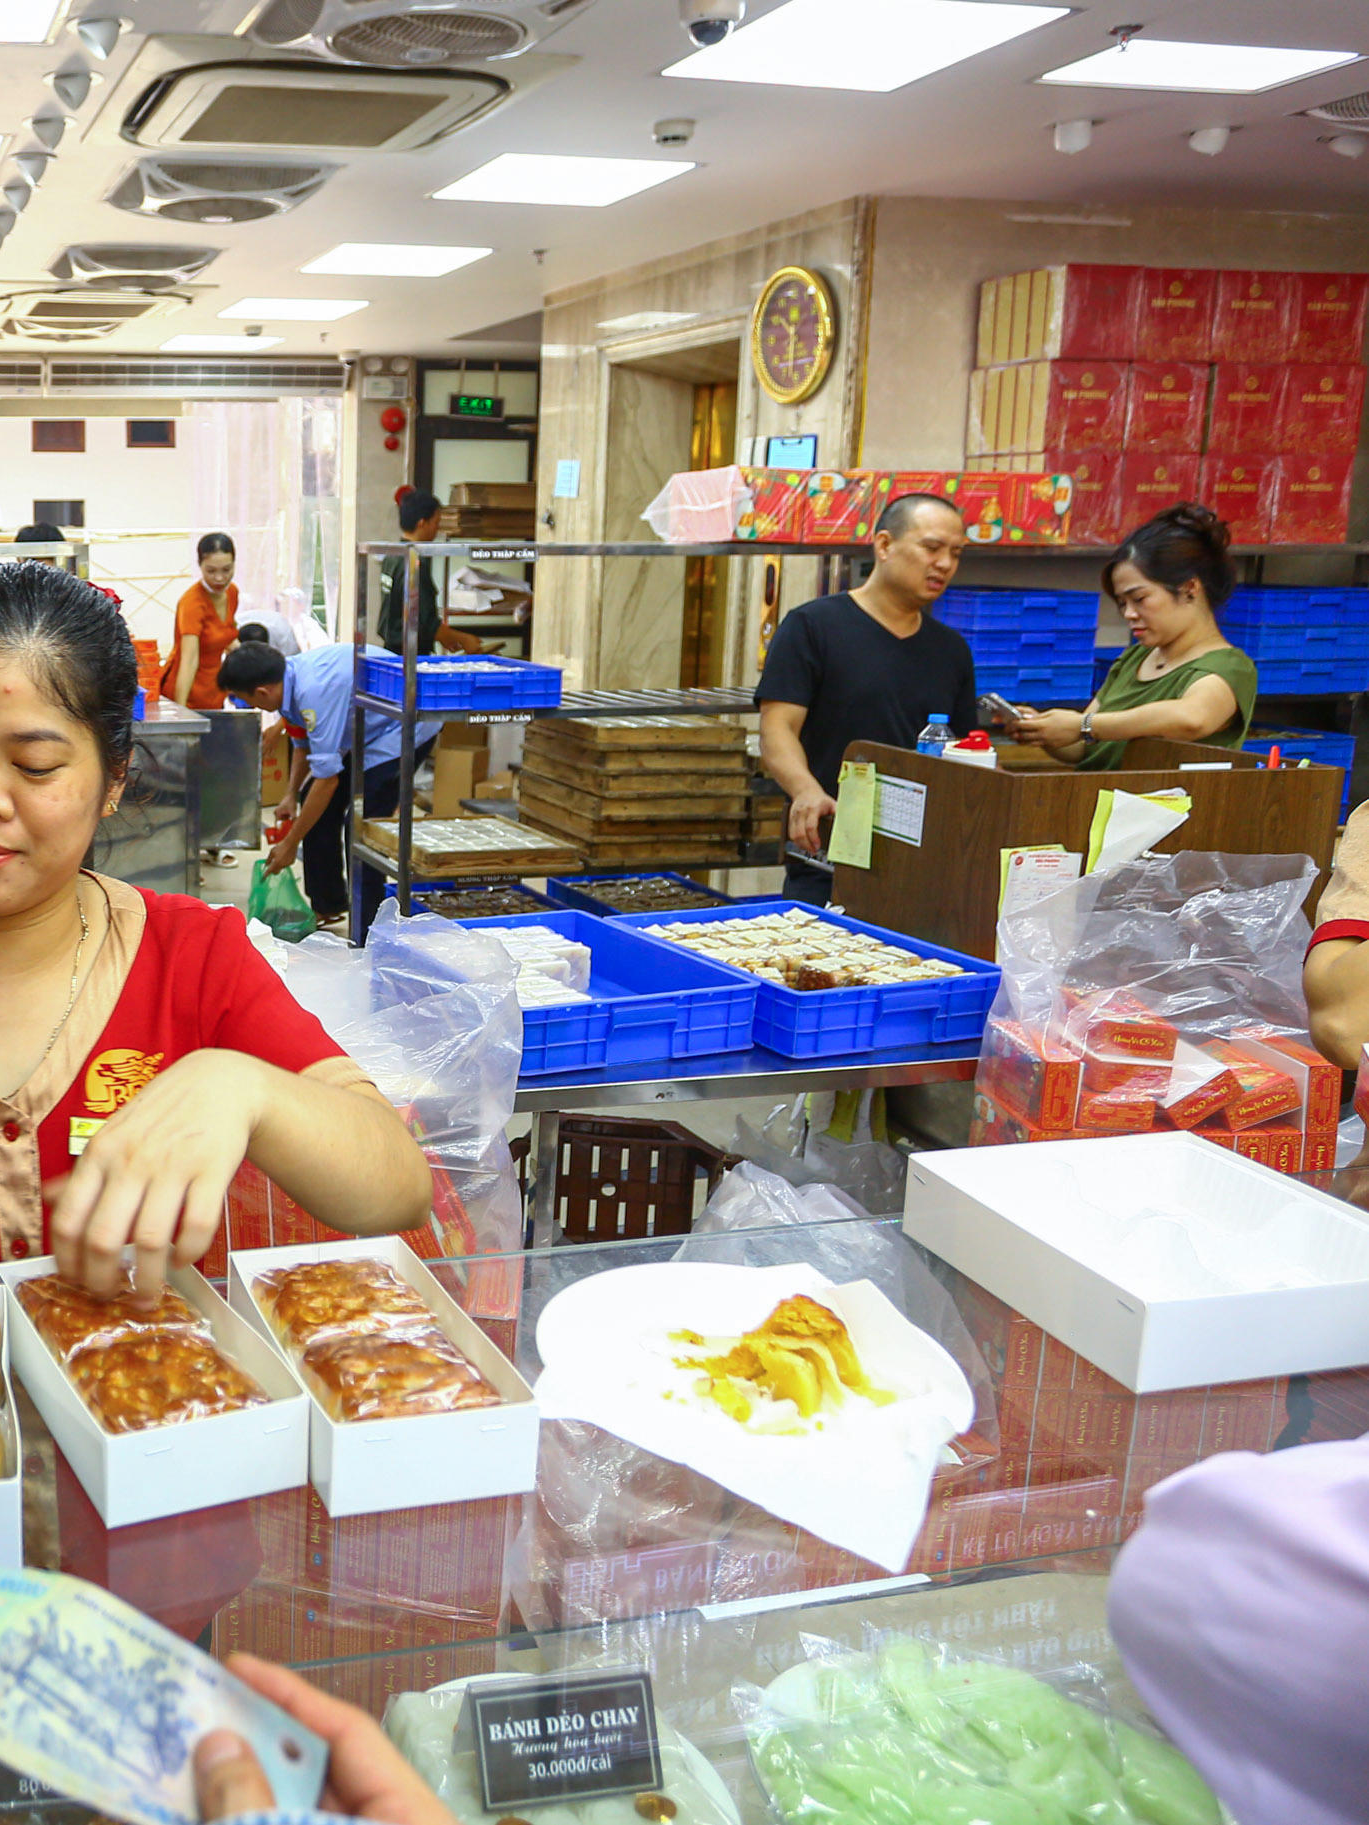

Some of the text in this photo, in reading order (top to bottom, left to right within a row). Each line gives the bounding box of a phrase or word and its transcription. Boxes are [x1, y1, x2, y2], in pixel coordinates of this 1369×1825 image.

[489, 1706, 639, 1742] BÁNH DẺO CHAY
[564, 1735, 588, 1749] hoa
